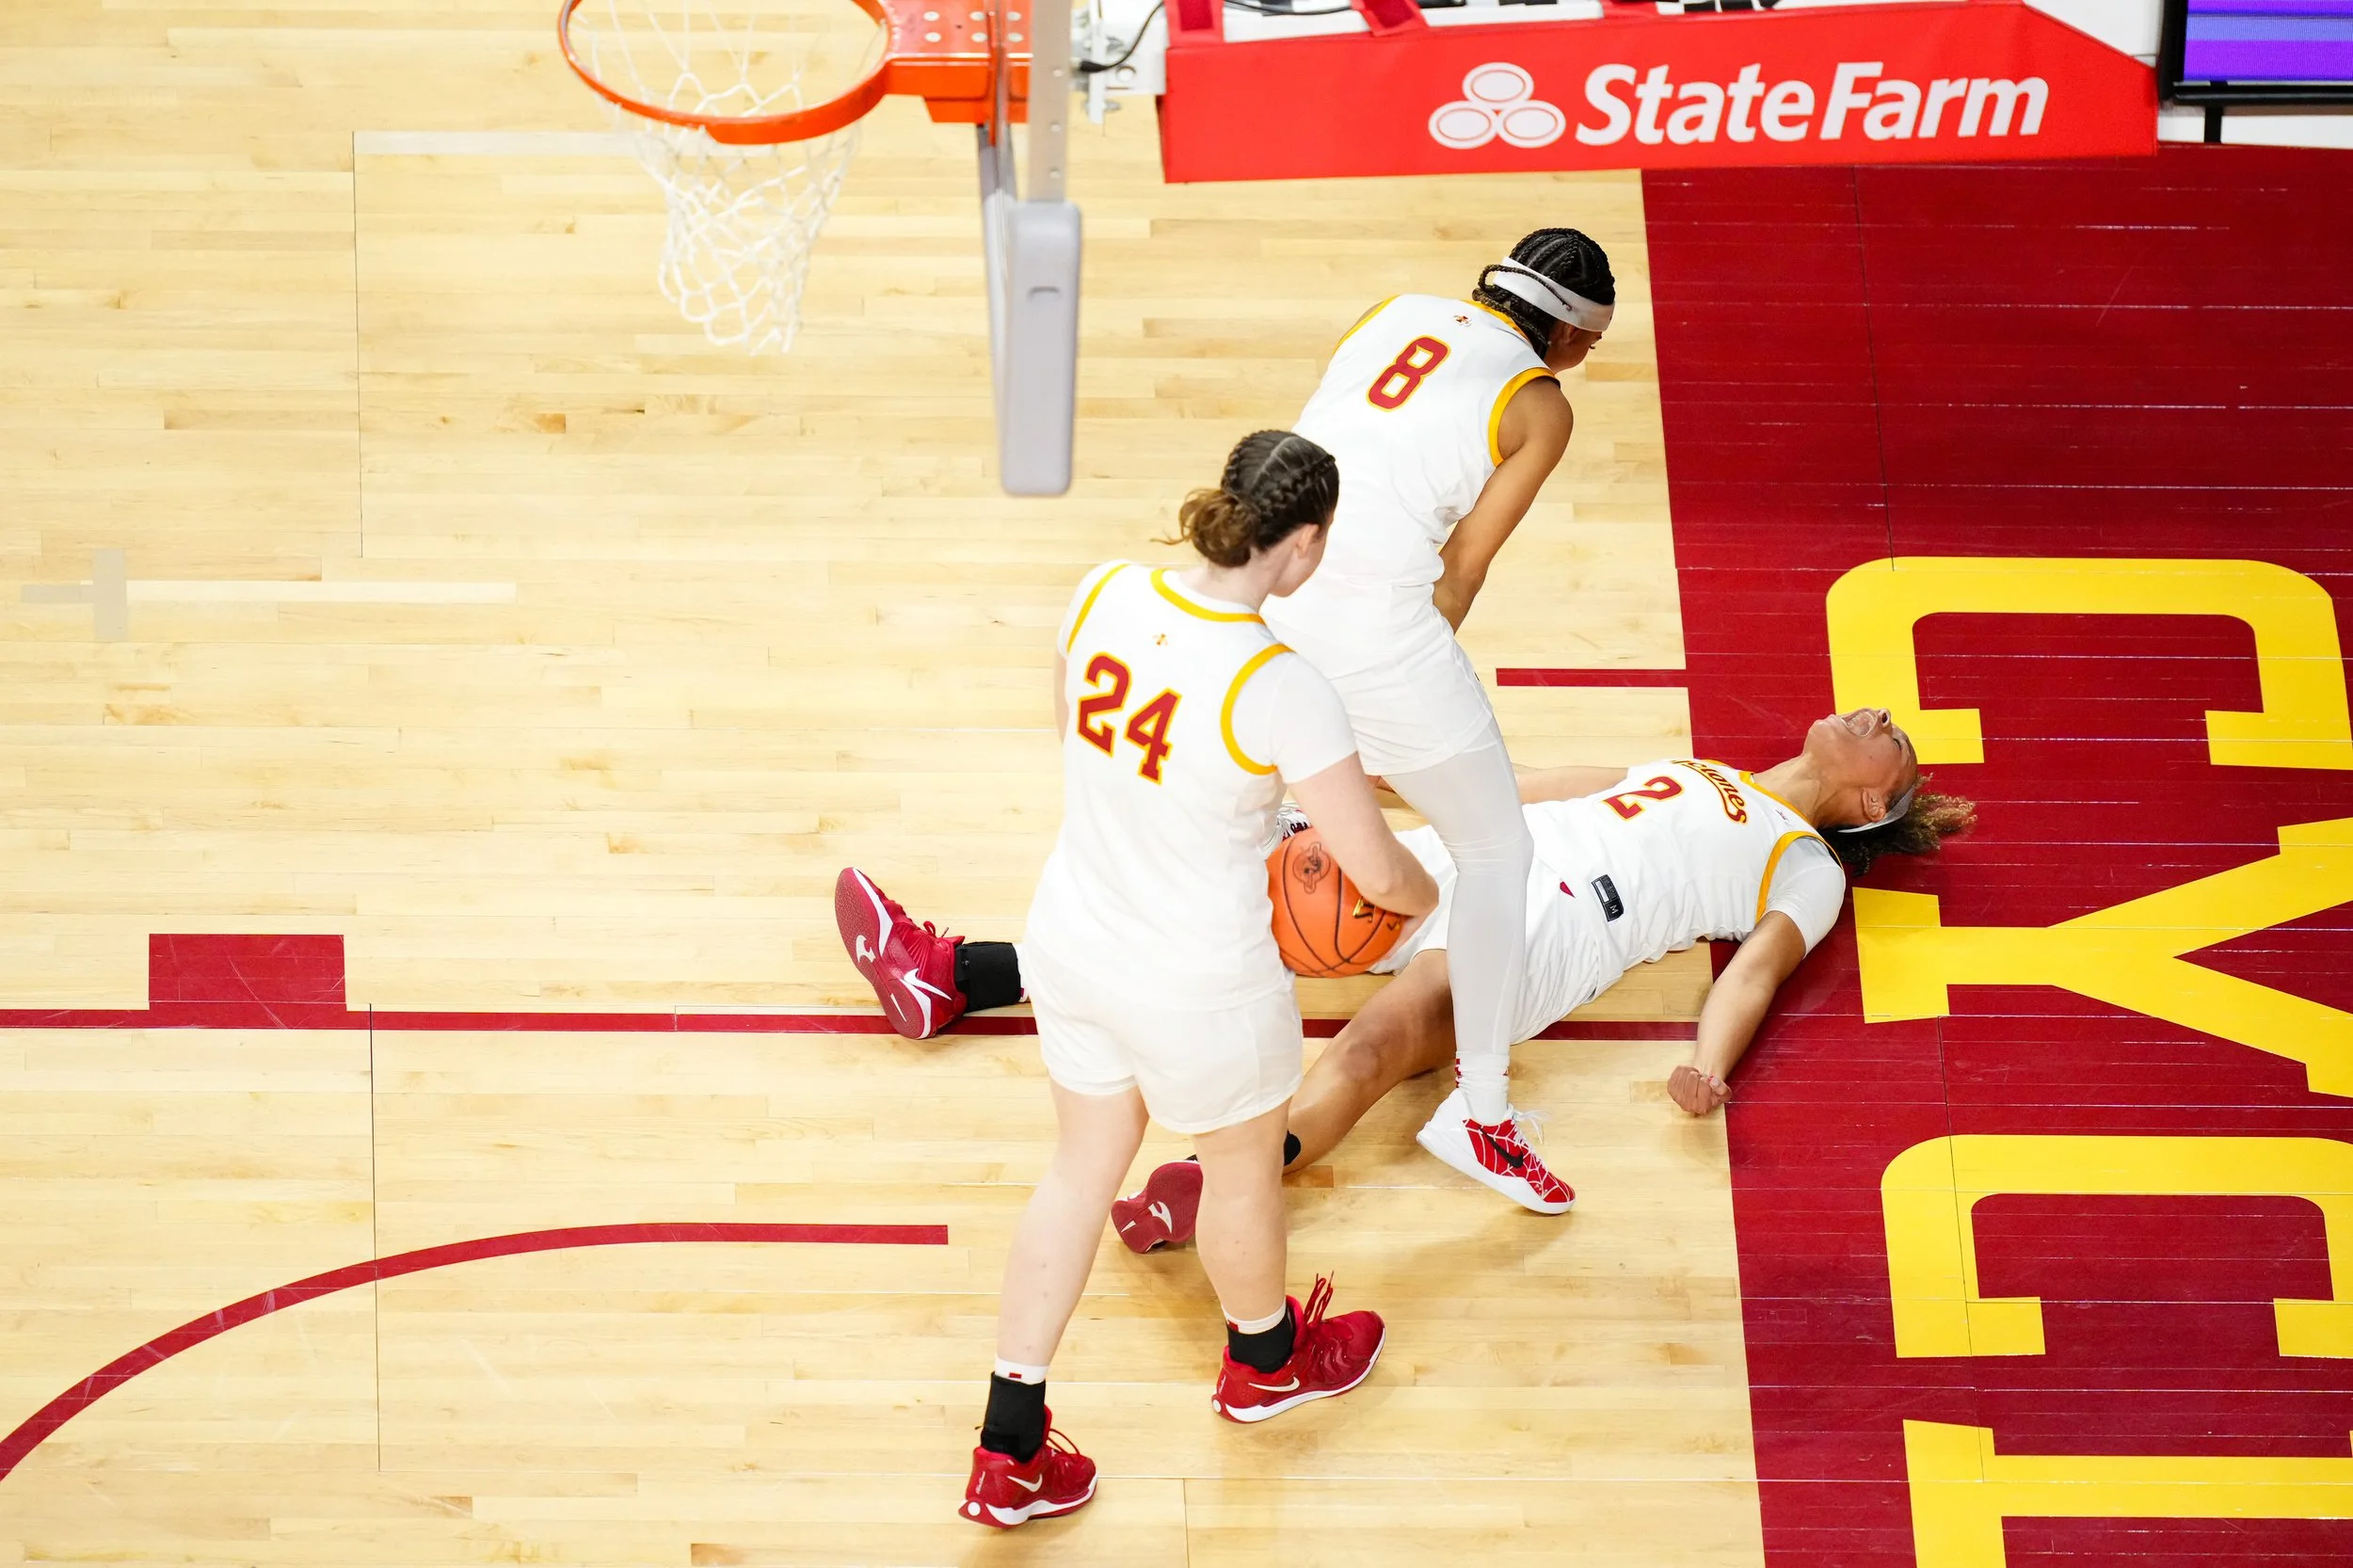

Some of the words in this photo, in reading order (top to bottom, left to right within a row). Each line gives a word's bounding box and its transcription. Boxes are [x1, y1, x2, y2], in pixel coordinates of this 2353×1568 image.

[1365, 335, 1451, 413] 8
[1076, 651, 1184, 787] 24
[1602, 776, 1686, 823] 2
